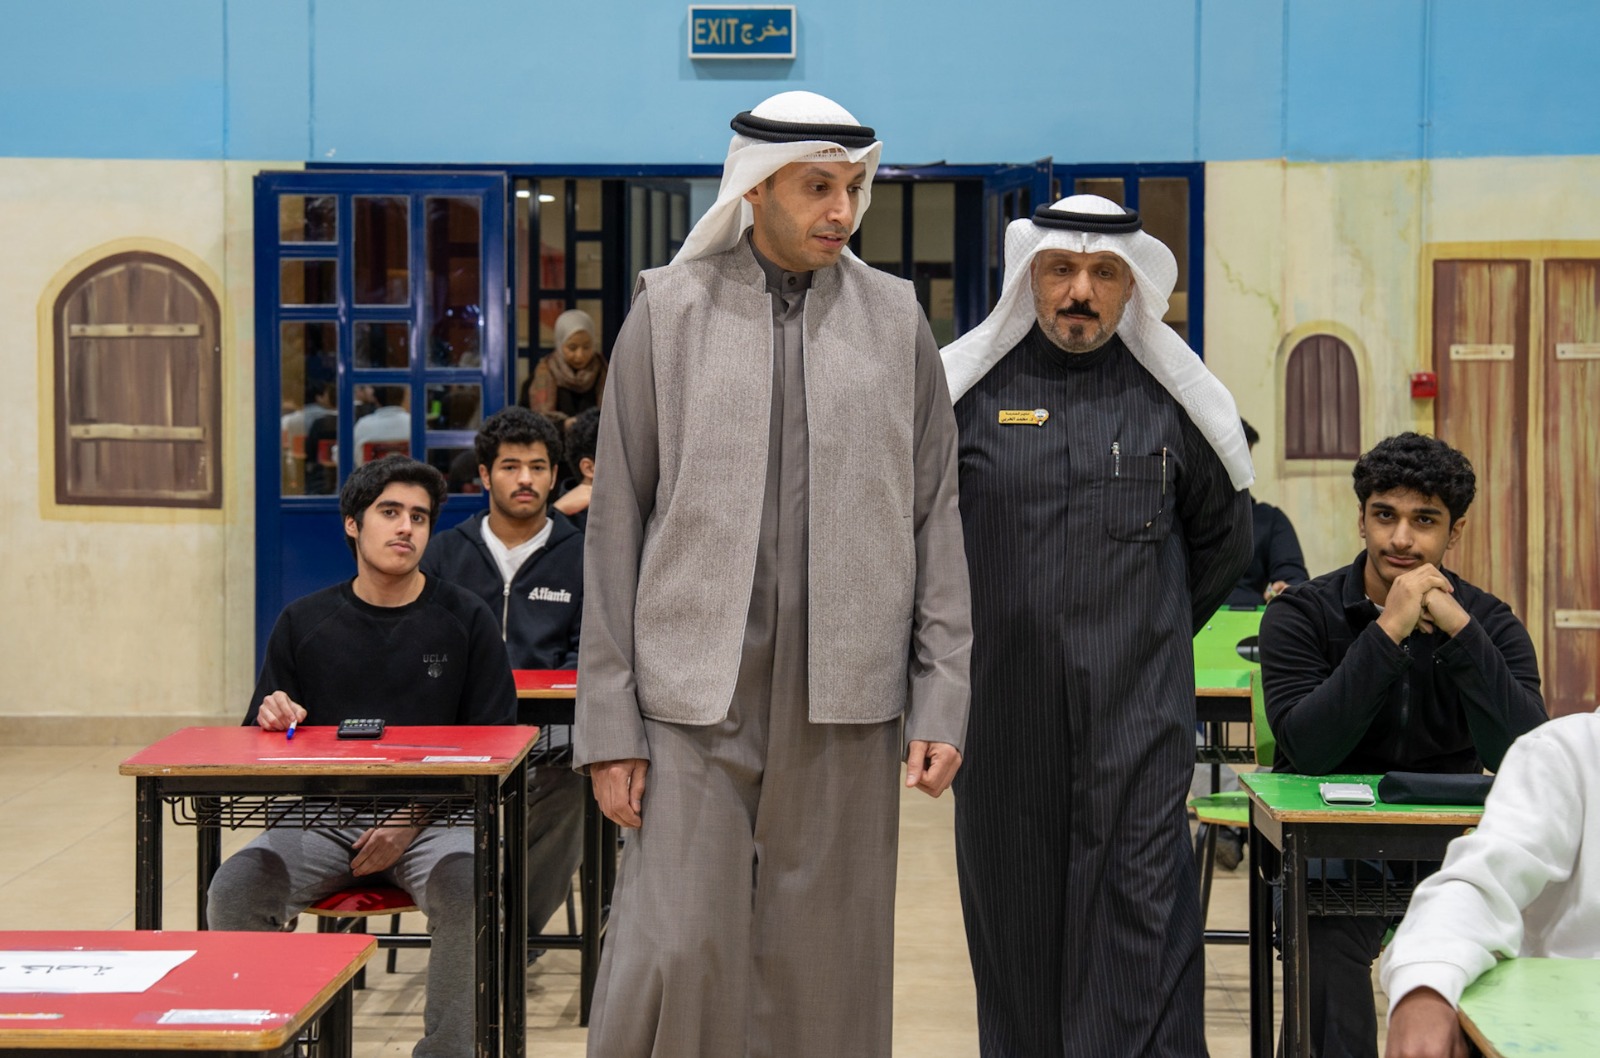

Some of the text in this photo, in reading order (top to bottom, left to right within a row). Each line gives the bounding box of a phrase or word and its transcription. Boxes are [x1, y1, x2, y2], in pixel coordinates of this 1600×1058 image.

[694, 17, 739, 45] EXIT
[741, 18, 788, 45] مخرج
[528, 587, 572, 603] Atlanta
[423, 654, 448, 663] UCLA
